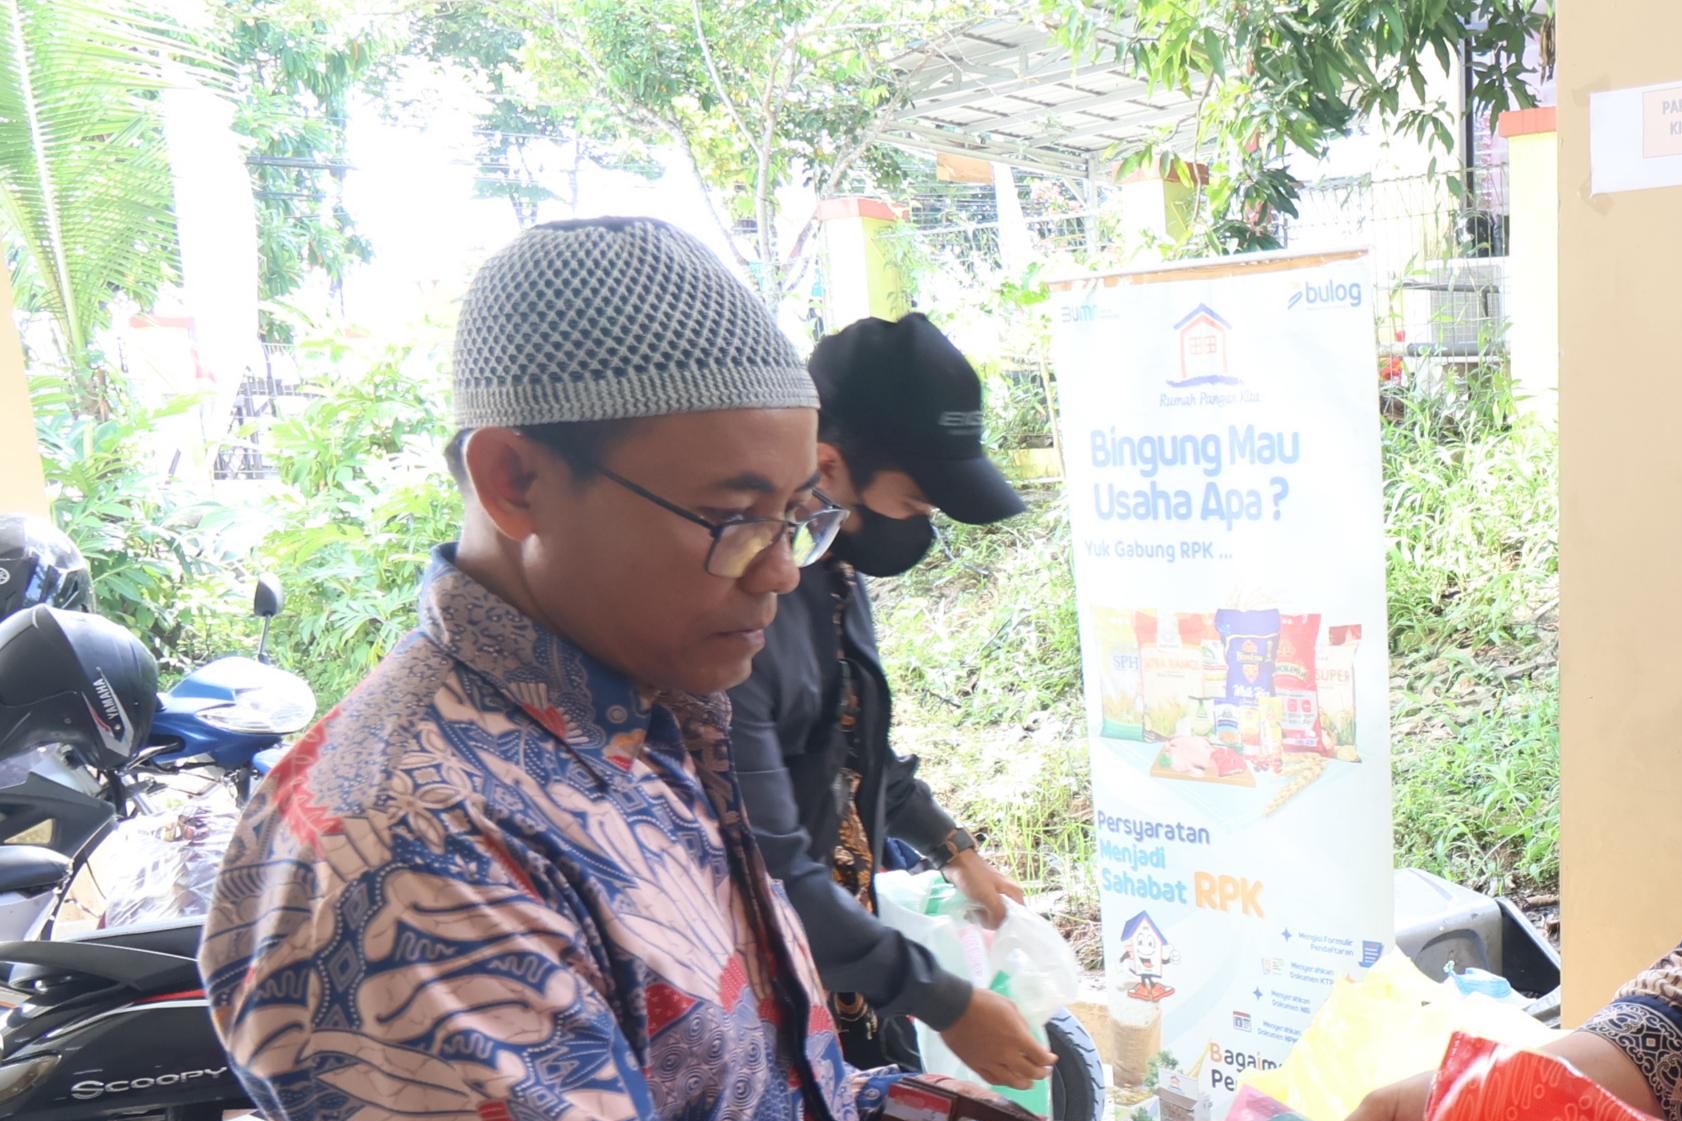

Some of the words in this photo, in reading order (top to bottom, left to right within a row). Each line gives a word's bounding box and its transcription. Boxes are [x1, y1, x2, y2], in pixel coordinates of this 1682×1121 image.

[1304, 278, 1362, 308] bulog
[1159, 391, 1196, 408] Rumah
[1090, 425, 1223, 478] Bingung
[1227, 424, 1300, 466] Mau
[1093, 480, 1193, 521] Usaha
[1200, 481, 1263, 532] Apa
[1084, 540, 1110, 558] Yuk
[1114, 540, 1176, 563] Gabung
[1180, 541, 1214, 560] RPK
[93, 677, 120, 721] YAMAHA
[1097, 810, 1211, 846] Persyaratan
[1100, 839, 1166, 872] Menjadi
[1101, 867, 1188, 905] Sahabat
[1193, 870, 1266, 919] RPK
[1210, 1041, 1283, 1073] Bagaim
[1211, 1068, 1238, 1092] Pe
